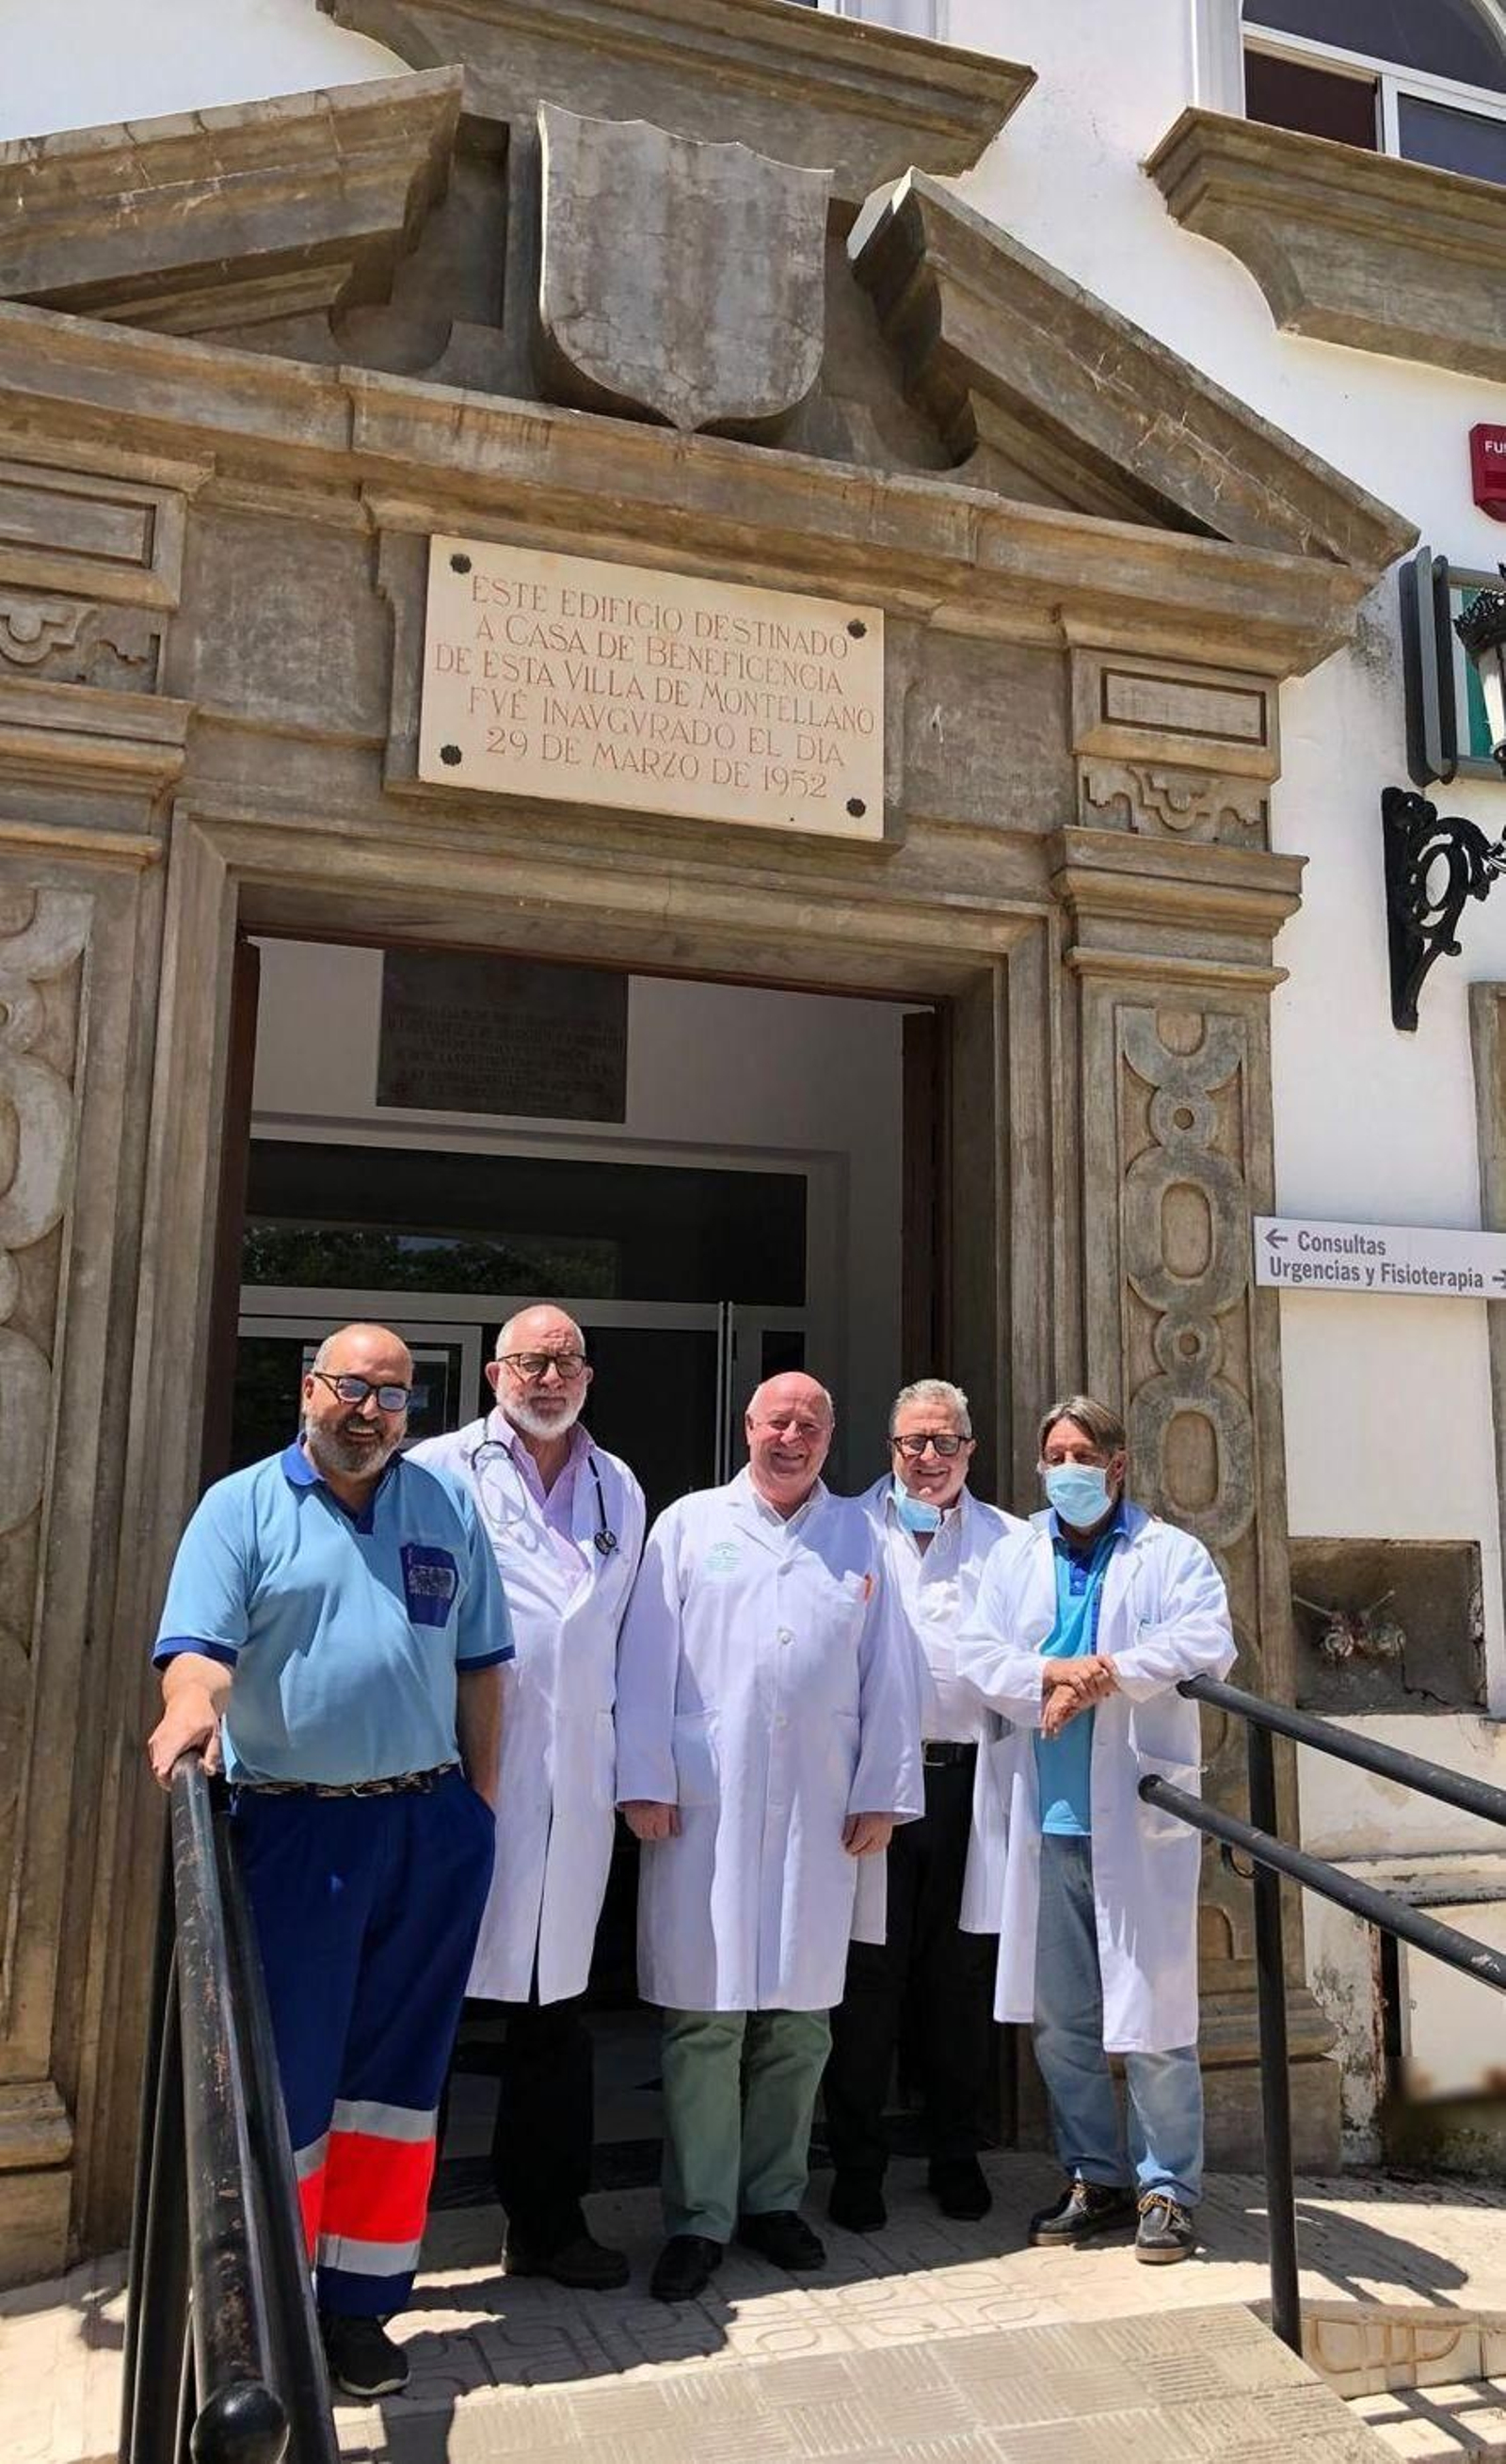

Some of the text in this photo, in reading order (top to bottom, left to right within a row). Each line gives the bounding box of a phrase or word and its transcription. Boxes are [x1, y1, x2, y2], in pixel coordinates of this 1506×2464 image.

[1484, 440, 1506, 454] FU
[473, 575, 848, 659] ESTE EDIFICIO DESTINADO
[476, 614, 843, 695] A CASA DE BENEFICENCIA
[435, 644, 874, 734] DE ESTA VILLA DE MONTELLANO
[487, 727, 826, 798] 29 DE MARZO DE 1952
[749, 728, 781, 757] EL
[796, 734, 845, 767] DIA
[1297, 1231, 1386, 1256] Consultas
[1270, 1256, 1484, 1291] Urgencias y Fisioterapia
